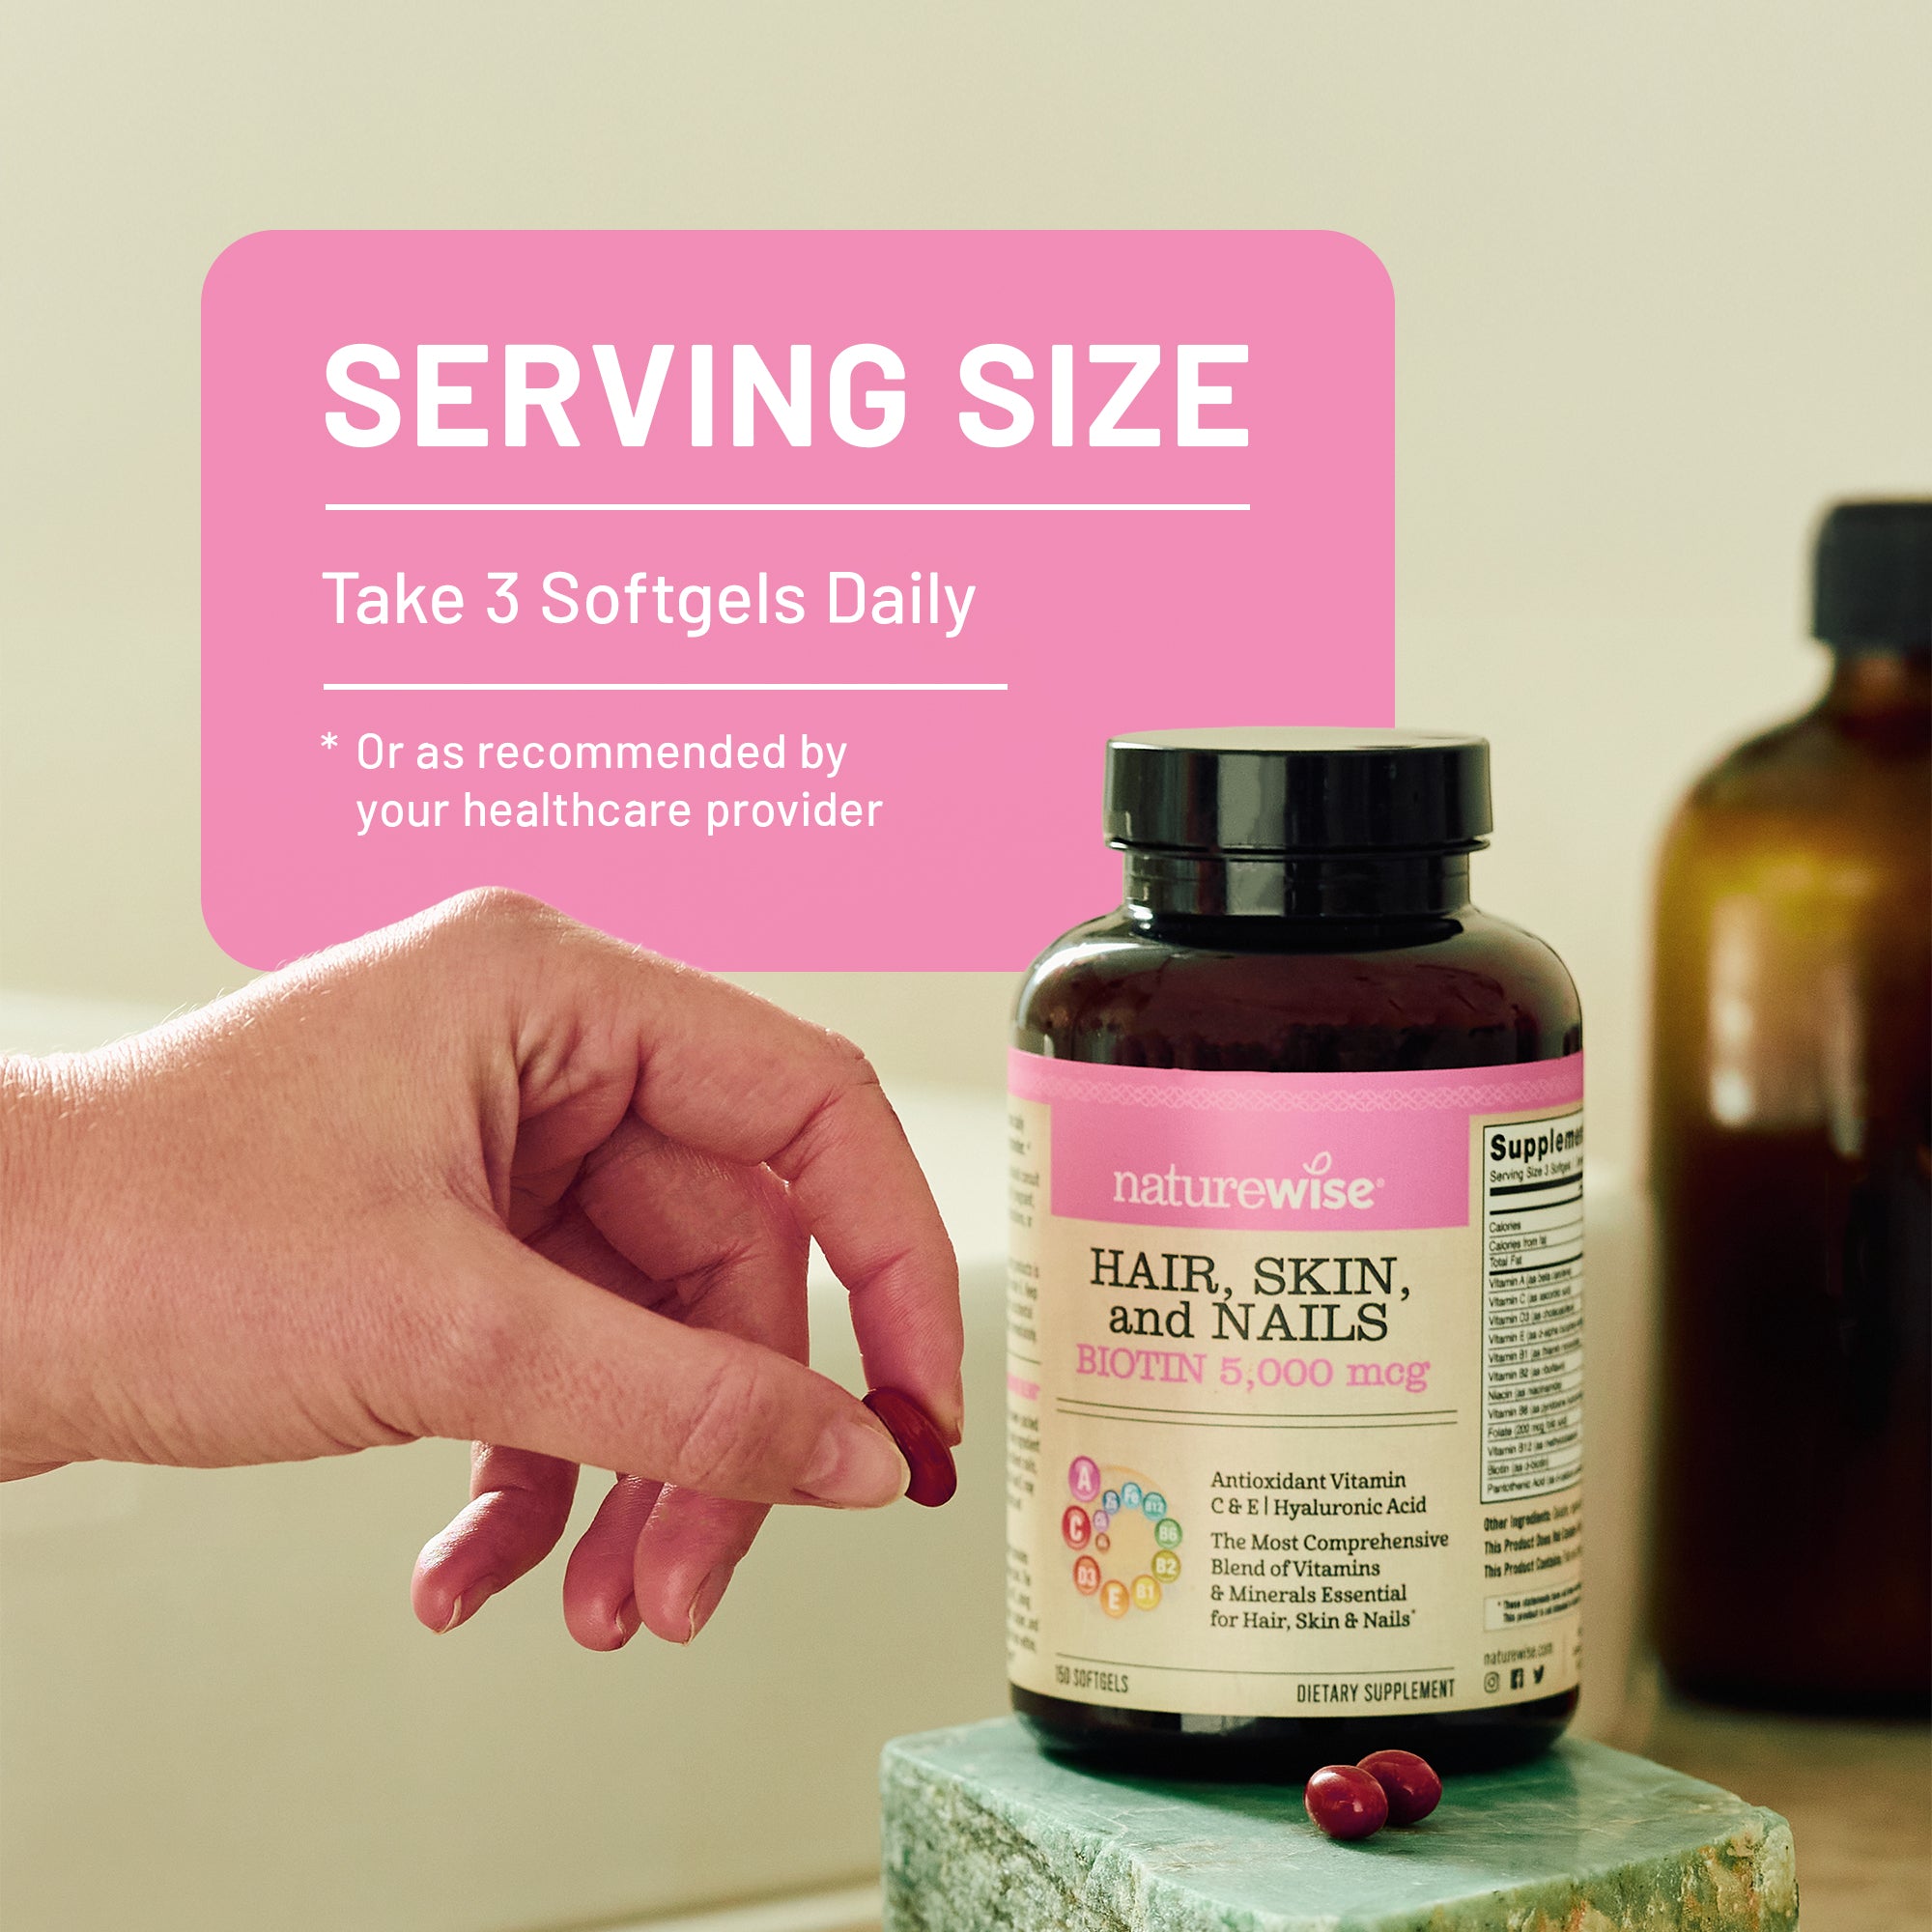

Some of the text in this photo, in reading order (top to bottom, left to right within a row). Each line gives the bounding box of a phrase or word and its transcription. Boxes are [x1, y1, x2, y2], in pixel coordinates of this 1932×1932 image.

[1490, 1170, 1523, 1183] Serving
[1526, 1166, 1543, 1179] Size
[1489, 1221, 1521, 1234] Calories
[1489, 1239, 1521, 1252] Calories
[1490, 1256, 1508, 1268] Total
[1091, 1247, 1233, 1301] HAIR,
[1255, 1257, 1409, 1301] SKIN,
[1489, 1275, 1519, 1289] Vitamin
[1489, 1295, 1518, 1308] Vitamin
[1110, 1301, 1388, 1342] and NAILS
[1489, 1315, 1518, 1326] Vitamin
[1489, 1333, 1518, 1345] Vitamin
[1489, 1352, 1518, 1364] Vitamin
[1076, 1343, 1431, 1393] BIOTIN 5,000 mcg
[1489, 1371, 1518, 1382] Vitamin
[1489, 1408, 1517, 1419] Vitamin
[1076, 1465, 1092, 1492] A
[1210, 1471, 1406, 1490] Antioxidant Vitamin
[1210, 1497, 1225, 1515] C
[1228, 1498, 1242, 1515] &
[1247, 1498, 1260, 1516] E
[1274, 1498, 1382, 1520] Hyaluronic
[1386, 1495, 1427, 1515] Acid
[1069, 1515, 1083, 1542] C
[1159, 1526, 1179, 1543] B6
[1210, 1530, 1449, 1556] The Most Comprehensive
[1485, 1540, 1501, 1554] This
[1155, 1557, 1177, 1575] B2
[1211, 1558, 1380, 1577] Blend of Vitamins
[1485, 1563, 1501, 1577] This
[1077, 1566, 1097, 1587] D3
[1108, 1588, 1121, 1610] E
[1136, 1583, 1155, 1600] B1
[1210, 1584, 1407, 1604] & Minerals Essential
[1209, 1610, 1238, 1629] for
[1242, 1611, 1292, 1632] Hair,
[1295, 1612, 1340, 1631] Skin
[1345, 1612, 1358, 1630] &
[1073, 1667, 1128, 1693] SOFTGELS
[1297, 1678, 1455, 1703] DIETARY SUPPLEMENT
